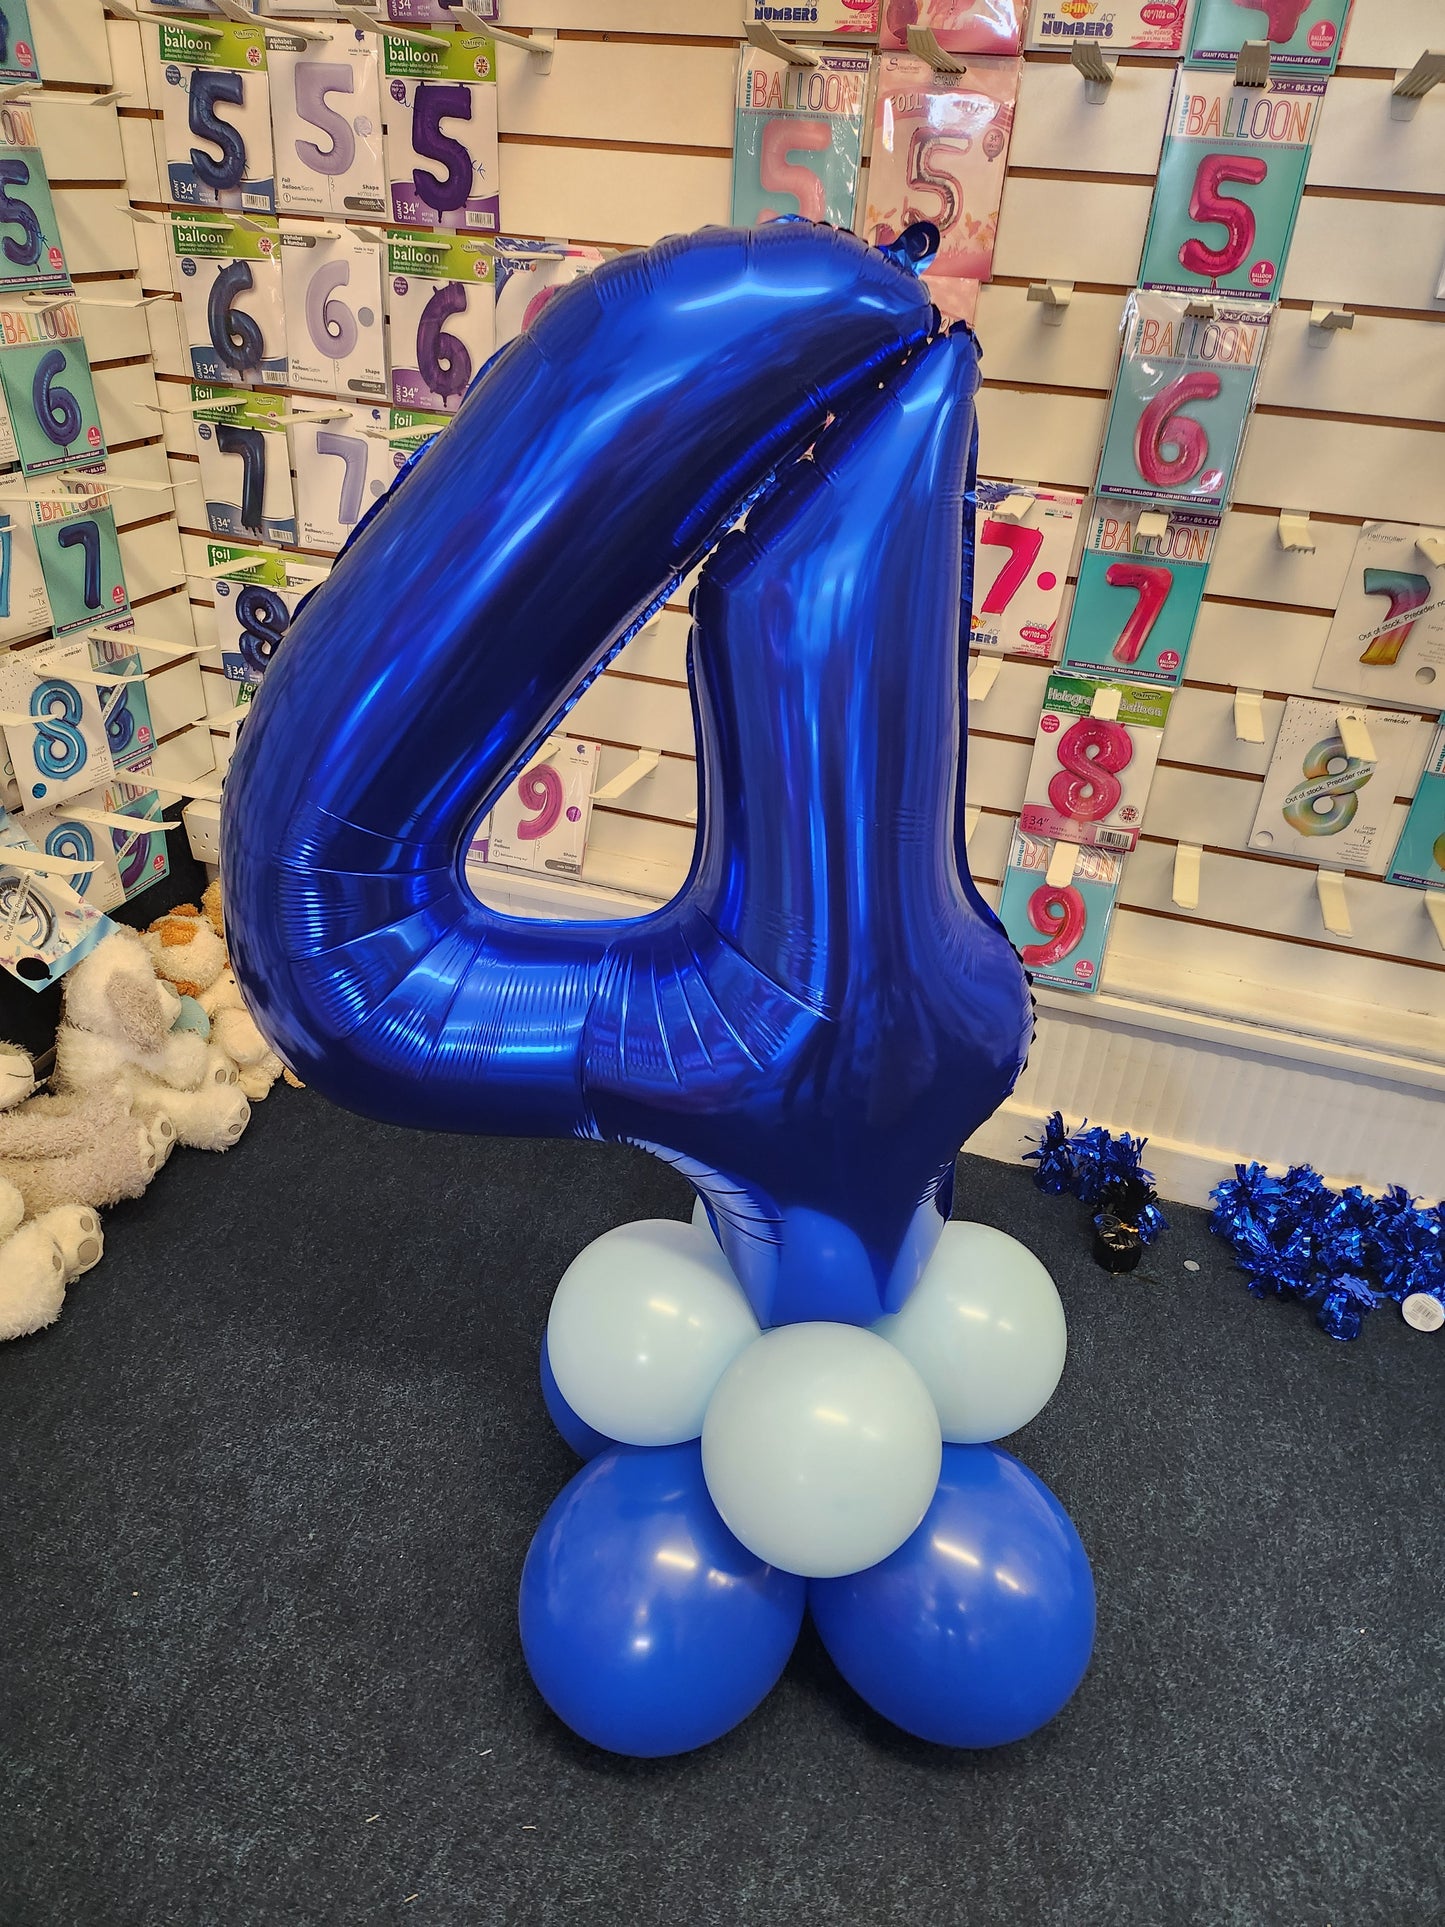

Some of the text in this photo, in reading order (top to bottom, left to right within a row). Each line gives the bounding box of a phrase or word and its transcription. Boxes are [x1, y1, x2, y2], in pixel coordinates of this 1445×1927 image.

[754, 7, 818, 21] NUMBERS
[1061, 1, 1098, 14] SHINY
[164, 33, 212, 51] balloon
[269, 37, 293, 45] Alphabet
[1042, 21, 1114, 37] NUMBERS
[1320, 25, 1327, 35] 1
[389, 46, 439, 63] balloon
[745, 69, 753, 107] unique
[752, 69, 861, 114] BALLOON
[1312, 85, 1325, 93] CM
[1178, 94, 1190, 135] unique
[1185, 95, 1313, 143] BALLOON
[412, 85, 473, 212] 5
[180, 181, 198, 195] 34"
[402, 201, 420, 215] 34"
[1177, 153, 1269, 278] 5
[177, 229, 225, 244] balloon
[393, 247, 440, 264] balloon
[1260, 263, 1267, 273] 1
[207, 260, 264, 373] 6
[305, 259, 359, 360] 6
[416, 281, 472, 400] 6
[1139, 319, 1258, 365] BALLOON
[203, 363, 218, 375] 34"
[33, 348, 83, 447] 6
[194, 386, 213, 399] foil
[402, 386, 419, 398] 34"
[394, 413, 412, 426] foil
[1133, 371, 1221, 487] 6
[214, 423, 266, 537] 7
[1156, 491, 1173, 499] BALLON
[1094, 517, 1104, 549] unique
[1100, 518, 1210, 561] BALLOON
[57, 520, 101, 610] 7
[211, 547, 231, 559] foil
[980, 517, 1045, 616] 7
[1104, 562, 1174, 665] 7
[1358, 631, 1373, 642] Out
[1373, 627, 1381, 637] of
[1403, 603, 1436, 622] Preorder
[1359, 567, 1431, 665] 7
[30, 679, 88, 780] 8
[1383, 717, 1409, 725] amscan
[1047, 715, 1134, 824] 8
[1285, 795, 1299, 804] Out
[1299, 791, 1306, 800] of
[1327, 771, 1356, 789] Preorder
[1356, 766, 1372, 777] now
[517, 763, 563, 841] 9
[1028, 815, 1050, 827] 34"
[1019, 882, 1088, 968] 9
